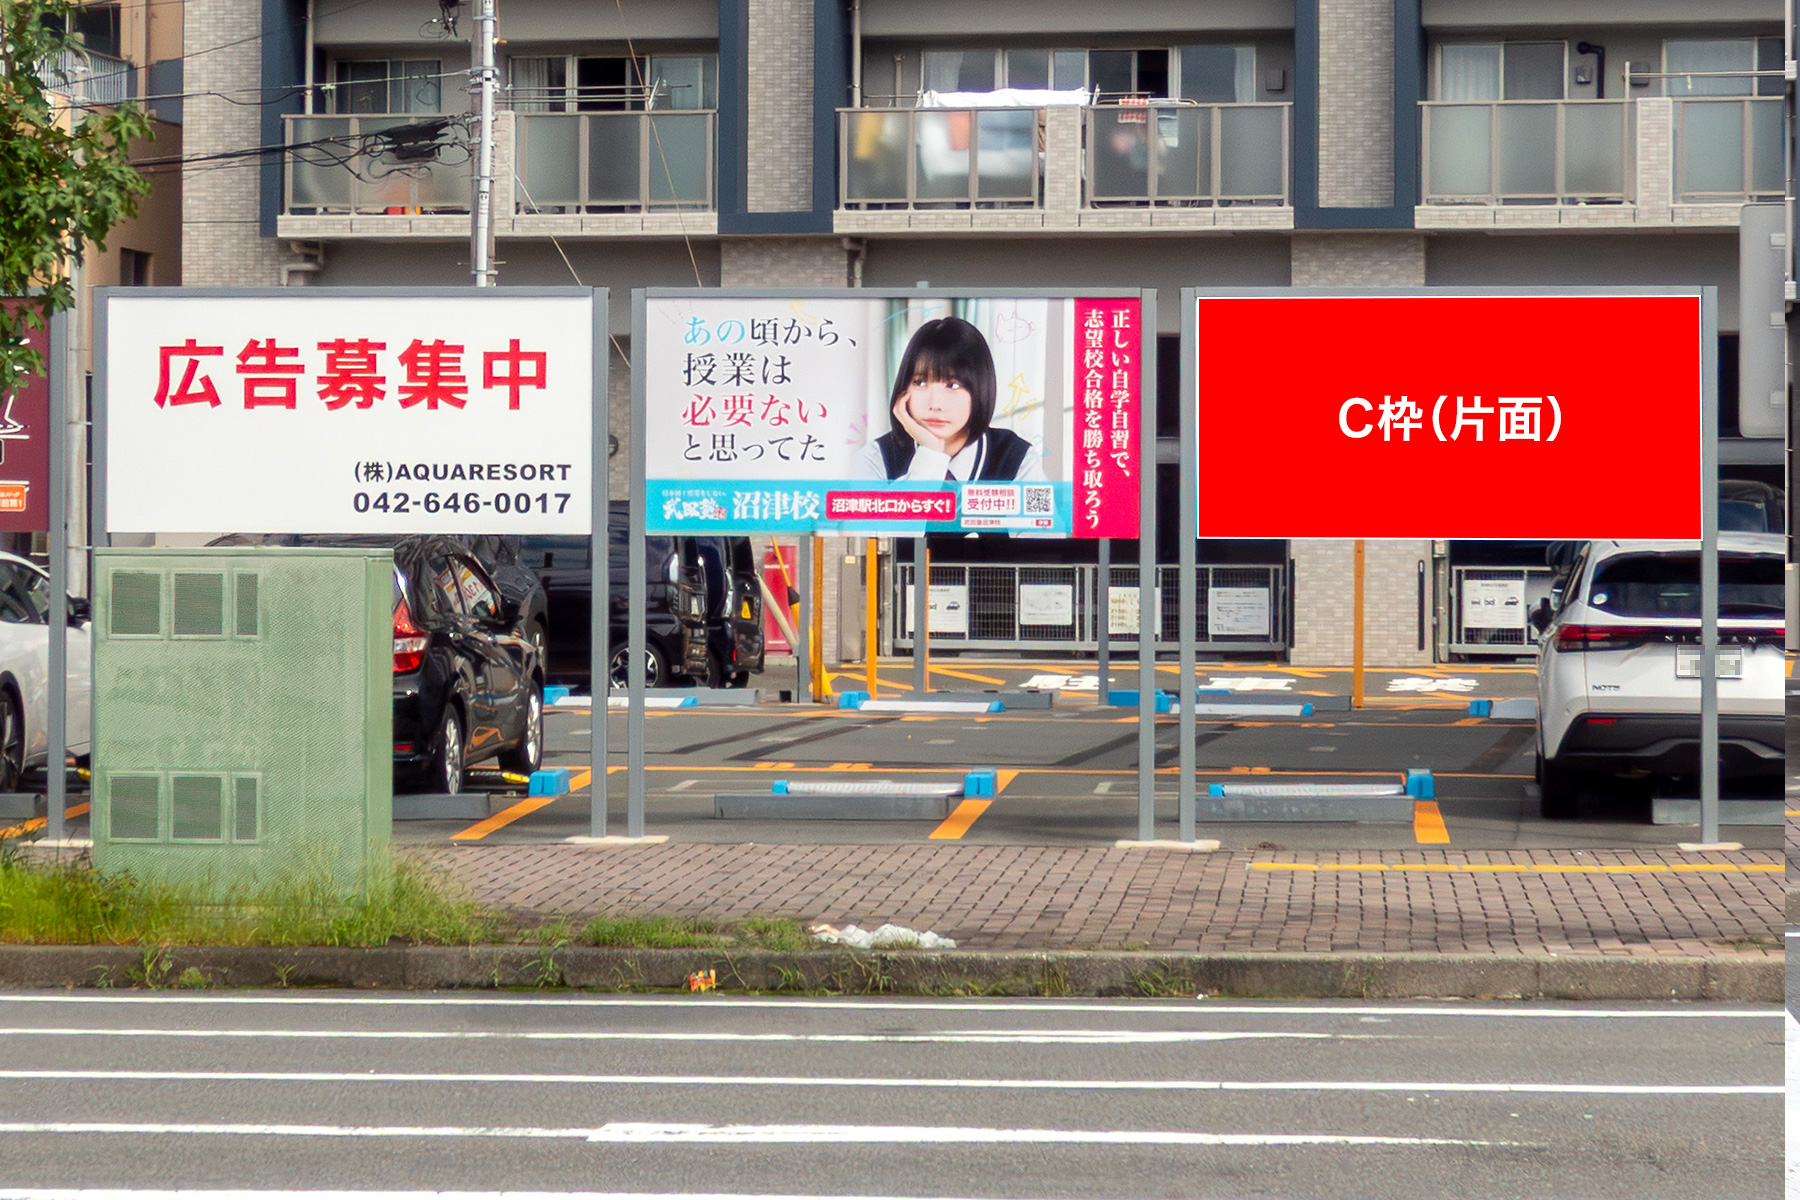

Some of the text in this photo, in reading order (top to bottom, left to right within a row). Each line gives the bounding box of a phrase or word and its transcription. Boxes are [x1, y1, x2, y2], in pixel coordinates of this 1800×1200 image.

[684, 316, 858, 347] あの頃から、
[153, 338, 548, 411] 広告募集中
[683, 352, 792, 387] 授業は
[1110, 309, 1130, 477] 正しい自学自習で、
[682, 393, 828, 428] 必要ない
[1083, 309, 1104, 529] 志望校合格を勝ち取ろう
[683, 433, 826, 462] と思ってた
[354, 461, 572, 483] (株)AQUARESORT
[353, 492, 572, 514] 042-646-0017
[733, 490, 820, 520] 沼津校
[832, 498, 951, 513] 沼津駅北口からすぐ!
[967, 497, 1015, 511] 受付中!!
